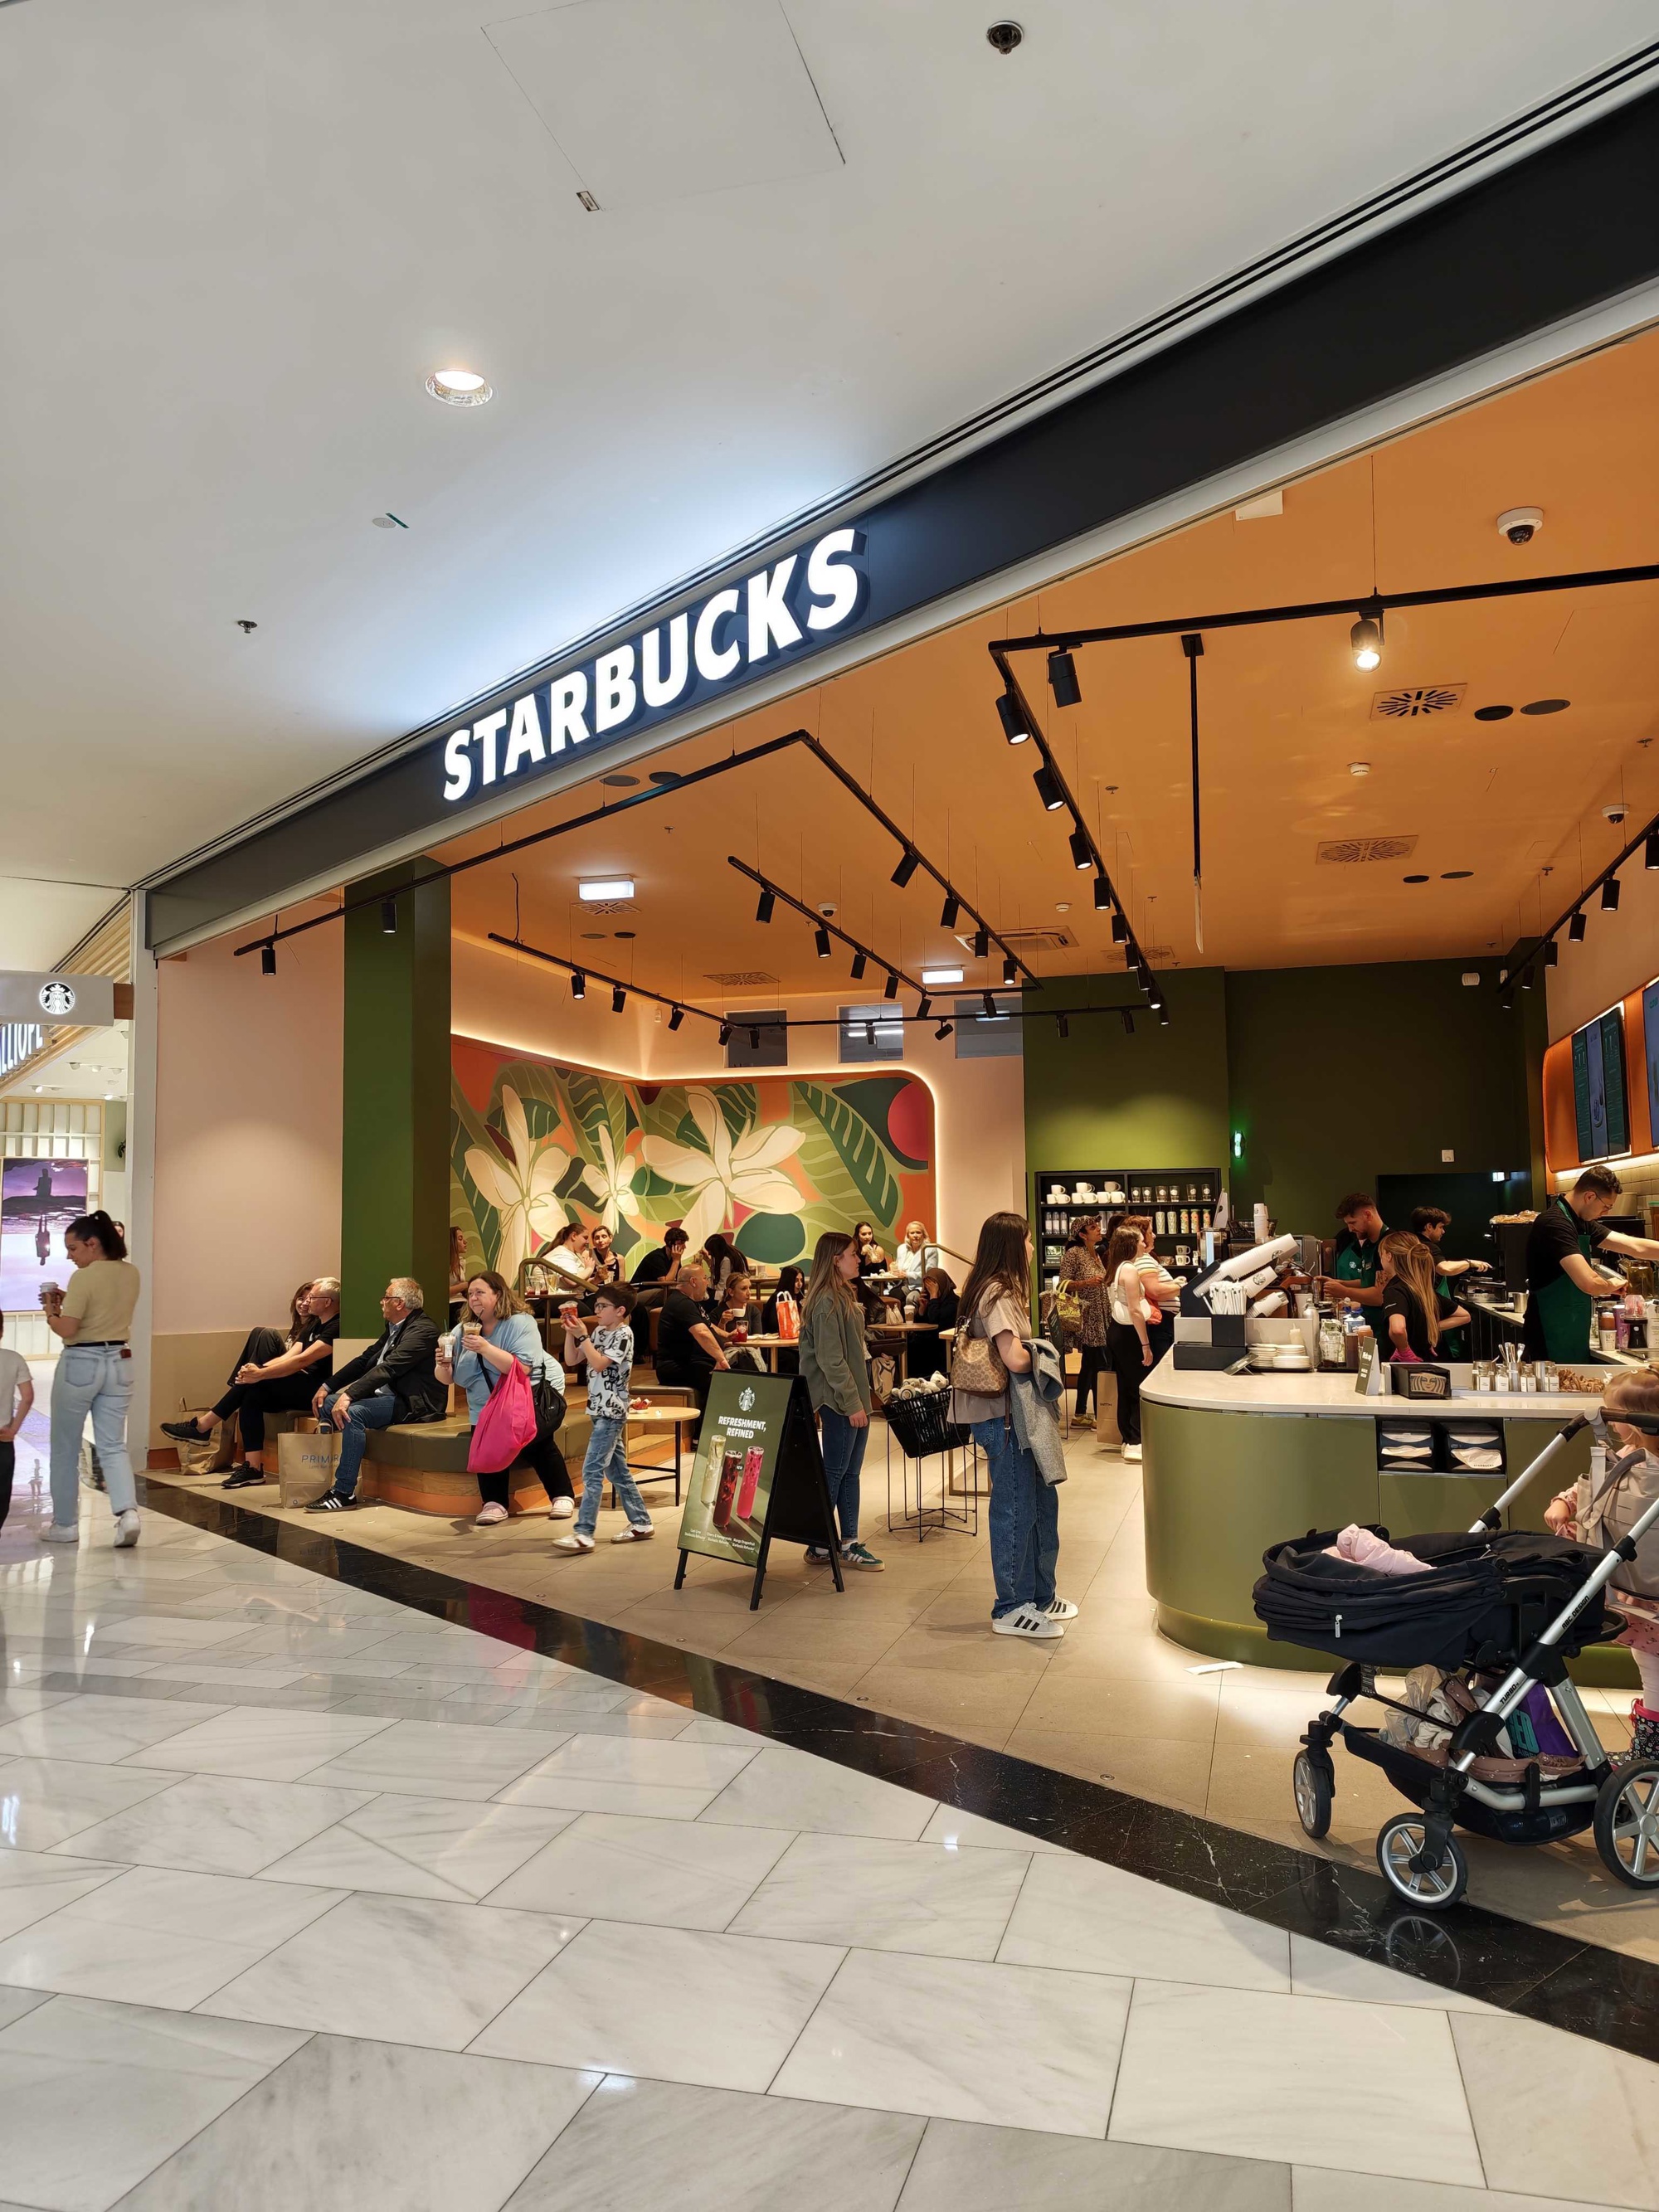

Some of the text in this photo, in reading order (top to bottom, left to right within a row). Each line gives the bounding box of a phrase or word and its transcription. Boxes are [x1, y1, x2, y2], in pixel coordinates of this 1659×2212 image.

[442, 528, 859, 801] STARBUCKS
[718, 1416, 766, 1432] REFRESHMENT,
[726, 1427, 754, 1439] REFINED
[301, 1454, 339, 1463] PRIMR
[1561, 1595, 1590, 1630] ABC DESIGN
[1499, 1684, 1518, 1705] TURBO
